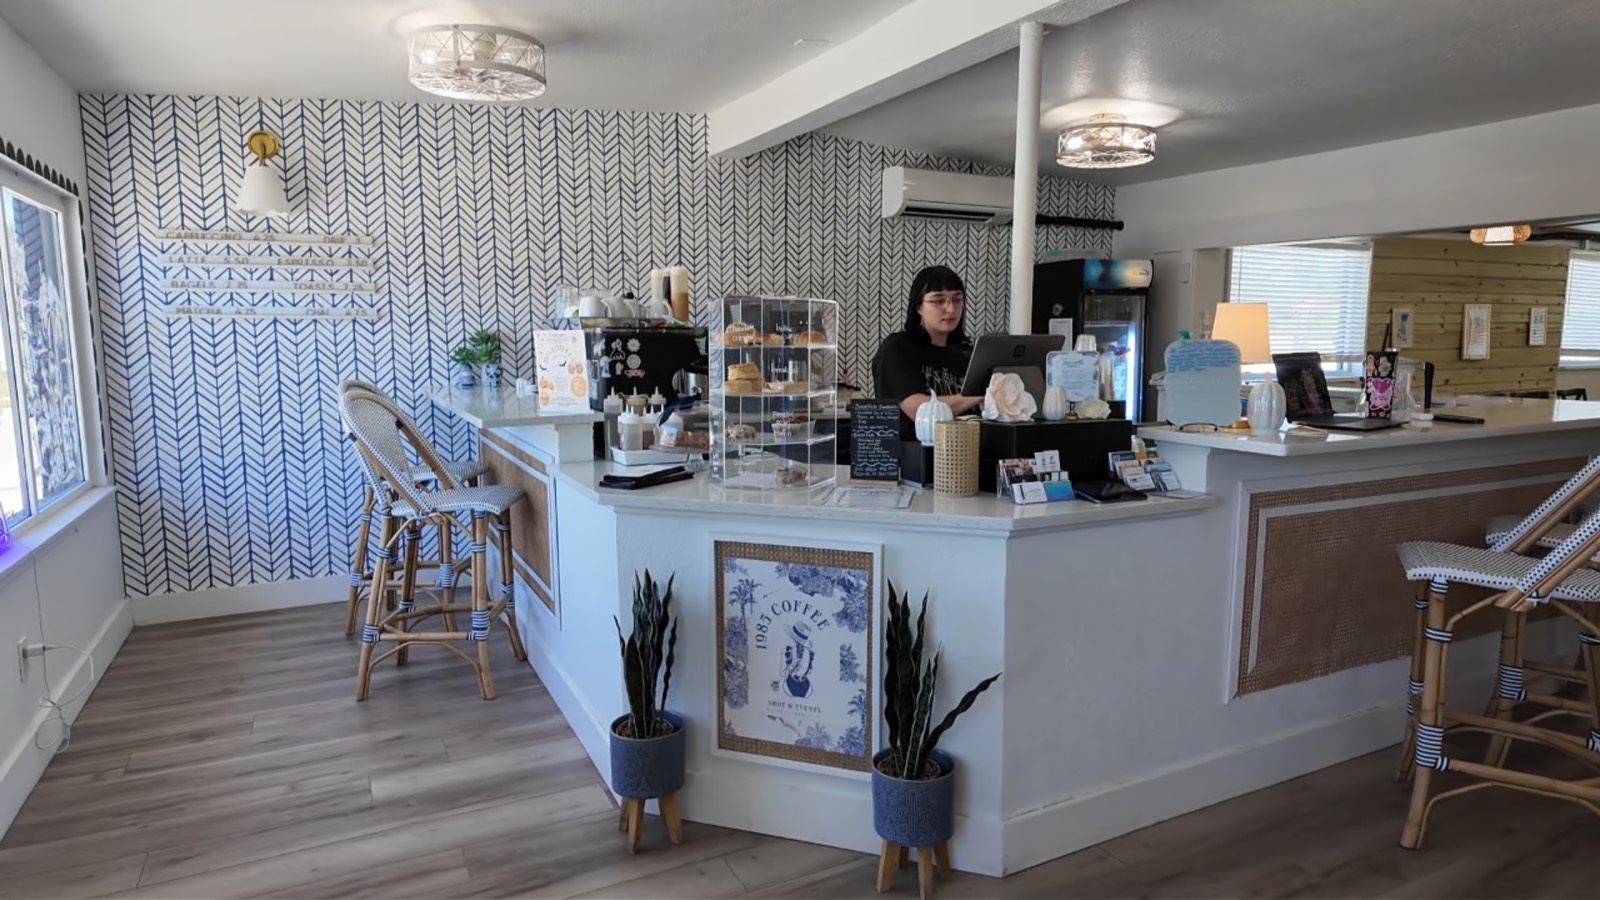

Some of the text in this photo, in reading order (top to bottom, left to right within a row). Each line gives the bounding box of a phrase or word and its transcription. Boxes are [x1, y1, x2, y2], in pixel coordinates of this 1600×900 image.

[166, 231, 242, 241] CAPPUCCINO
[169, 256, 207, 264] LATTE
[277, 258, 334, 266] ESPRESSO
[176, 307, 222, 315] MATCHA
[755, 599, 830, 650] 1985 COFFEE
[795, 704, 822, 714] EVENTS
